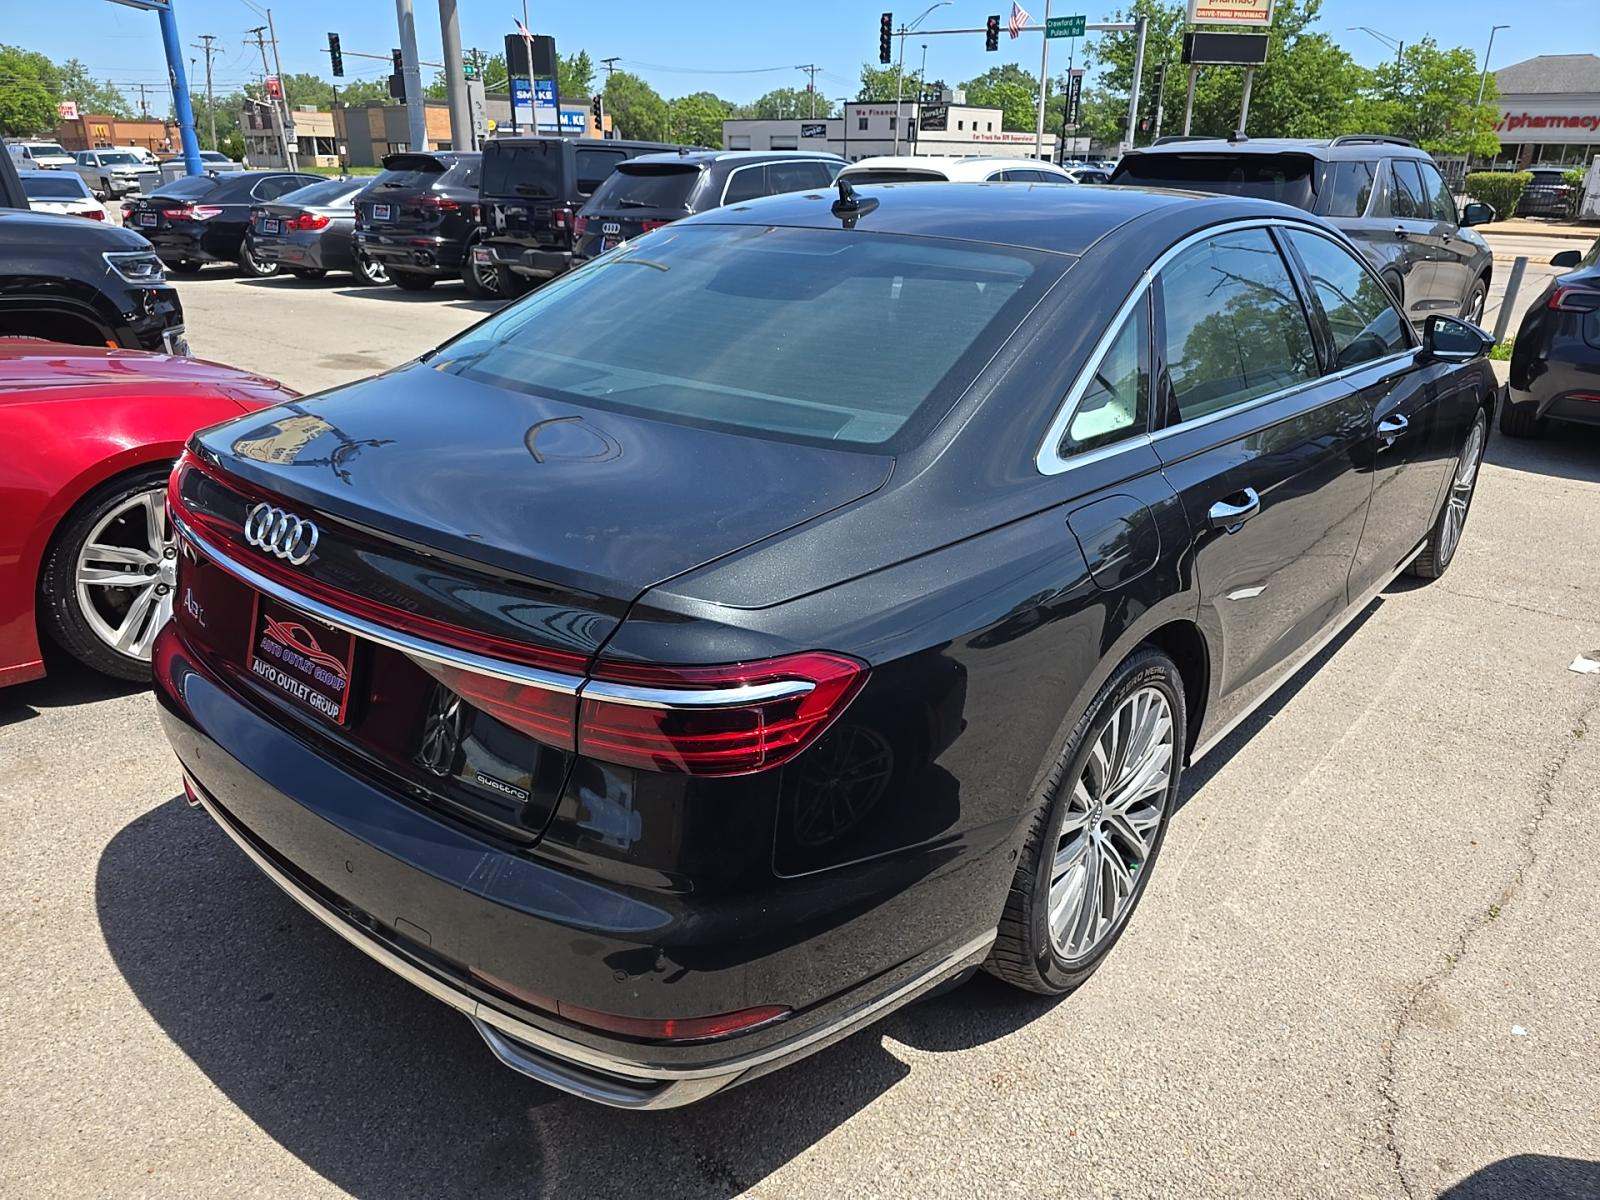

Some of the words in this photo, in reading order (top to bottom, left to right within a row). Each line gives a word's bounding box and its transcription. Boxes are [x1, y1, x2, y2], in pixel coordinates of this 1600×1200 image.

[1048, 19, 1073, 27] Crawford
[260, 637, 282, 657] AUTO
[282, 649, 315, 674] OUTLET
[314, 666, 346, 691] GROUP
[252, 660, 276, 680] AUTO
[277, 673, 310, 701] OUTLET
[310, 693, 339, 718] GROUP
[477, 775, 526, 799] quattro
